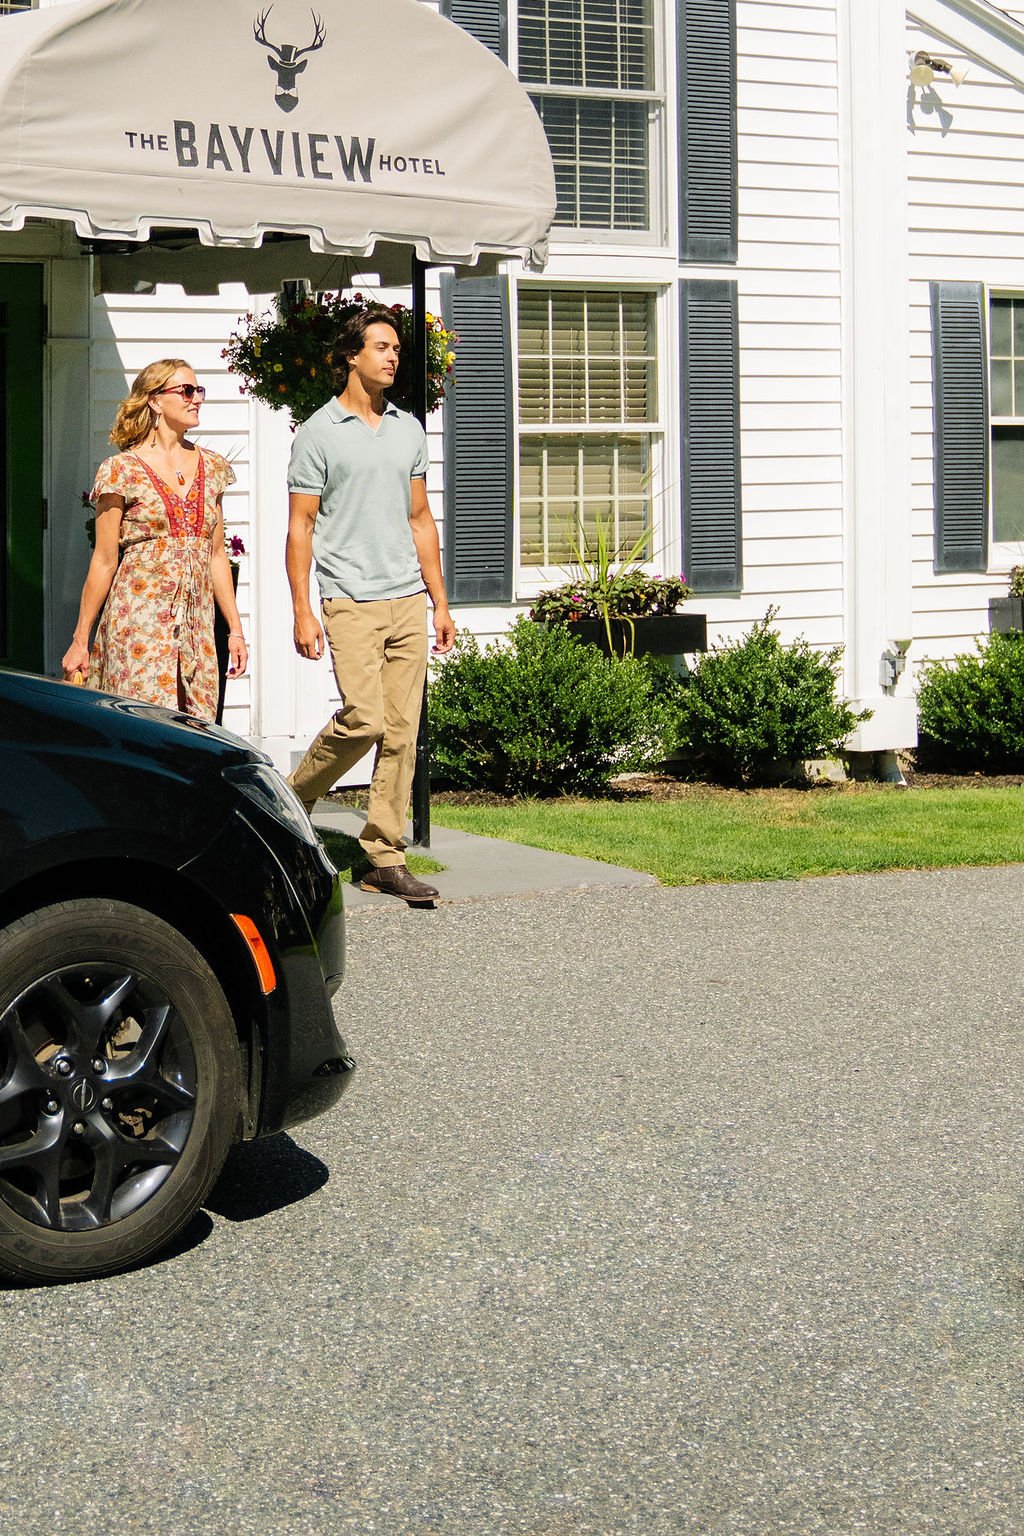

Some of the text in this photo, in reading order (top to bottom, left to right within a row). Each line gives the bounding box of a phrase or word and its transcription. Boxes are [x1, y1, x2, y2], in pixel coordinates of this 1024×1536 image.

[125, 120, 446, 183] THE BAYVIEW HOTEL
